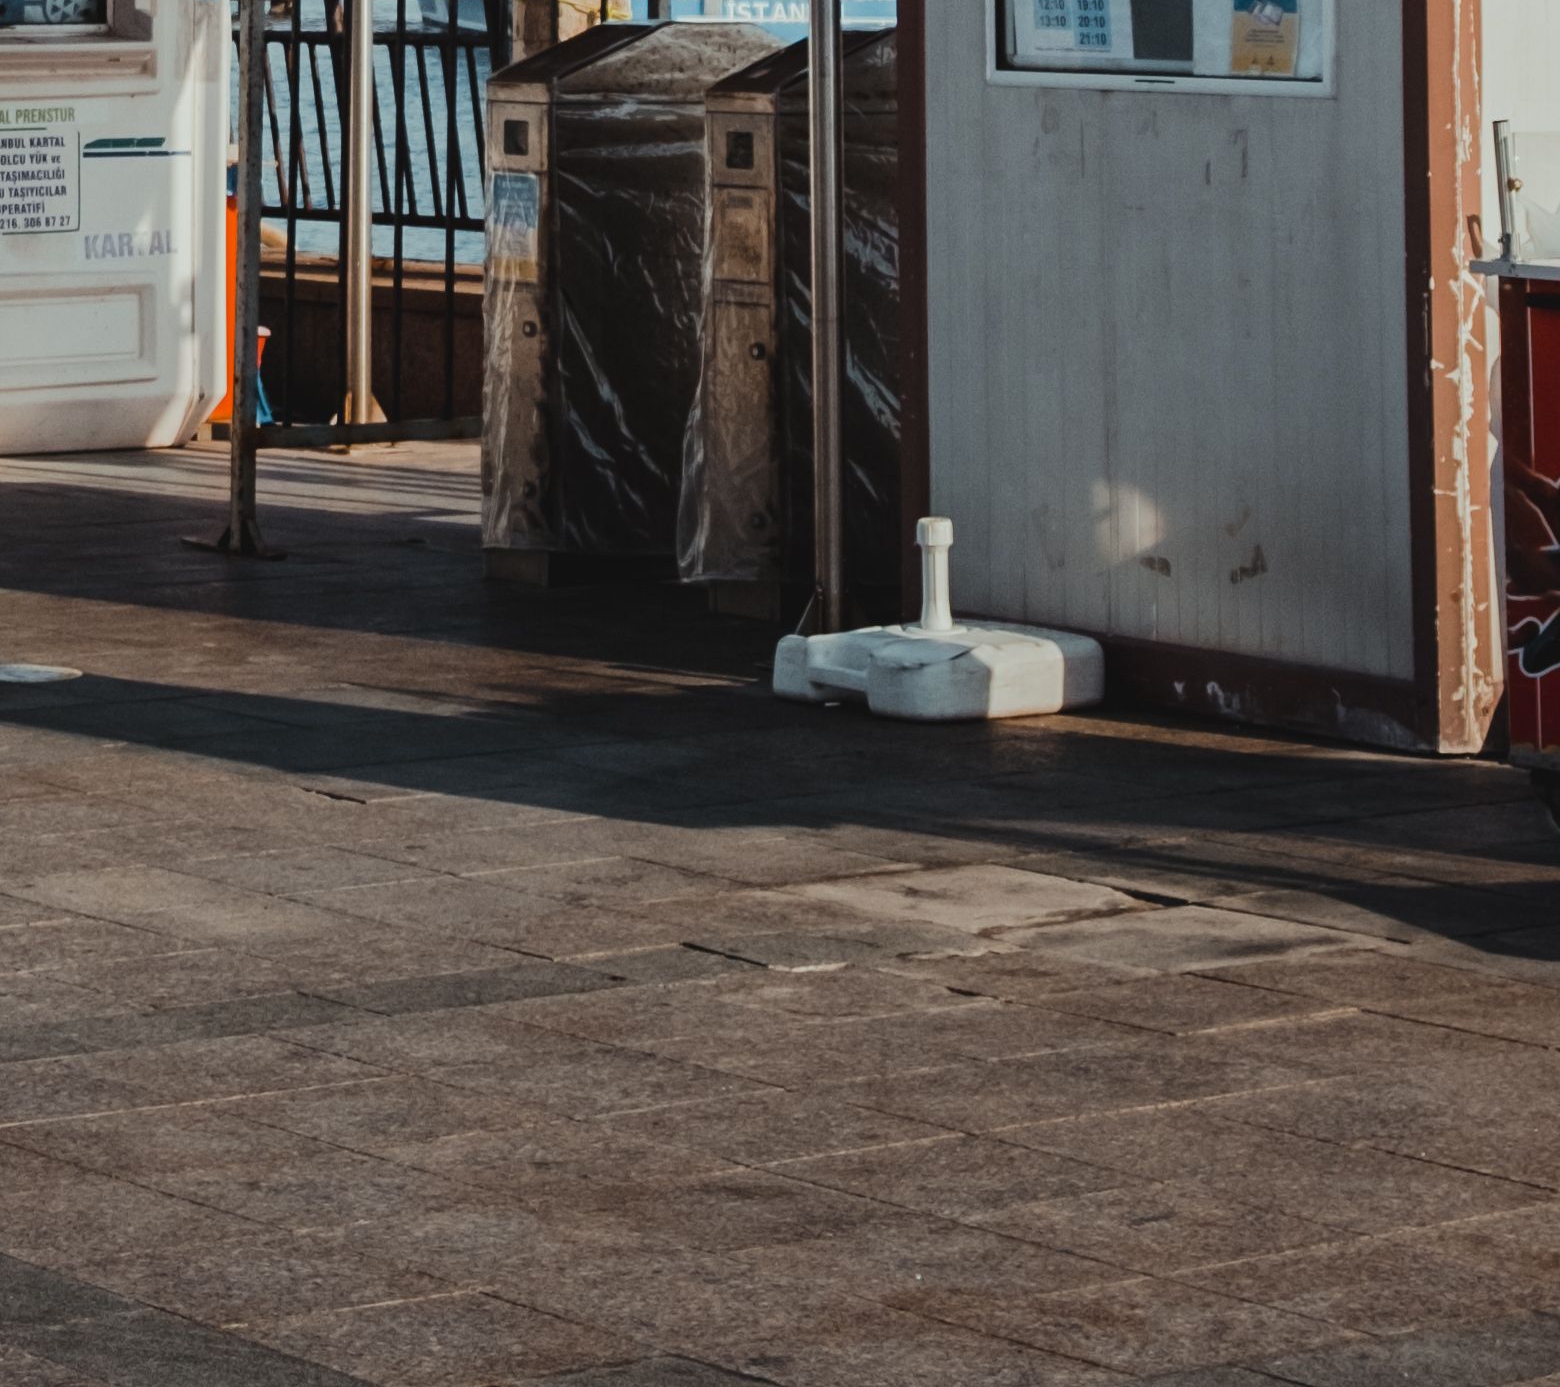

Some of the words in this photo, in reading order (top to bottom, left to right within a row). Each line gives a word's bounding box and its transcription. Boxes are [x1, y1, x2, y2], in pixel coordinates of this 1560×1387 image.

[15, 107, 75, 124] PRENSTUR
[30, 136, 66, 148] KARTAL
[59, 215, 71, 227] 27
